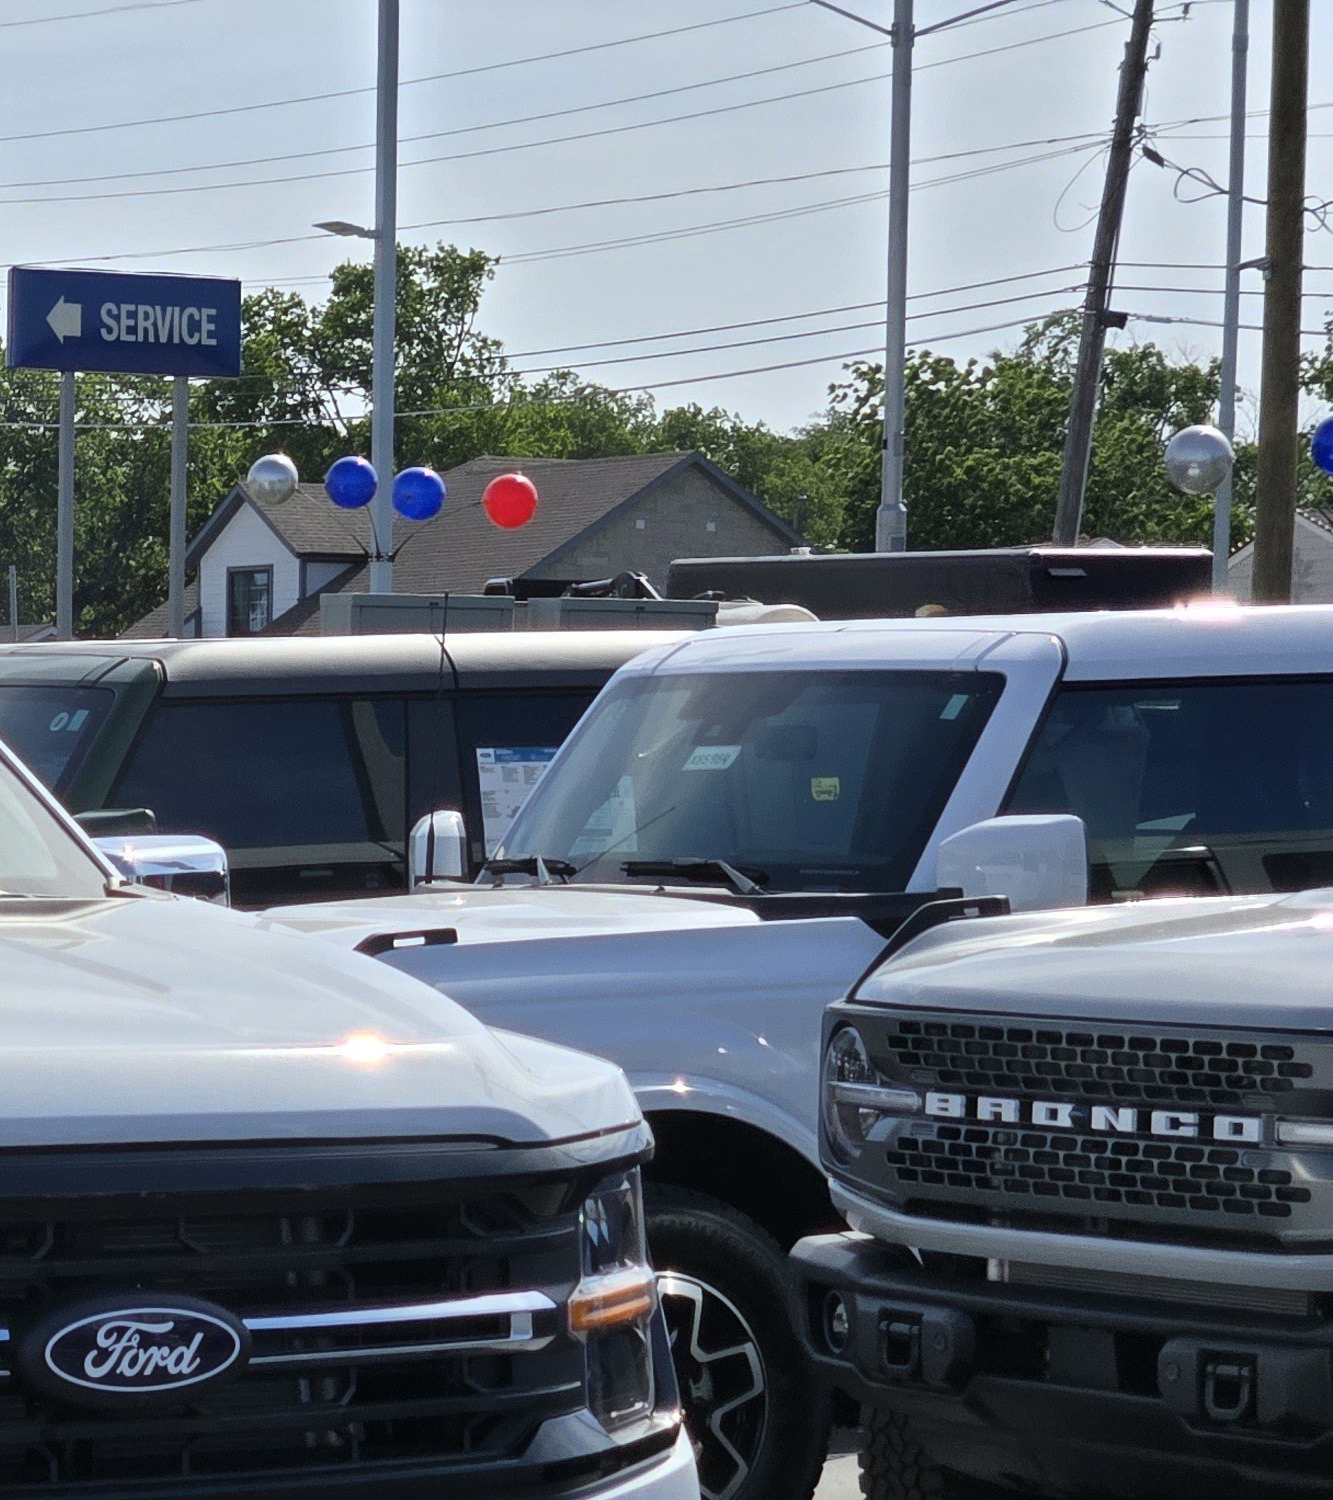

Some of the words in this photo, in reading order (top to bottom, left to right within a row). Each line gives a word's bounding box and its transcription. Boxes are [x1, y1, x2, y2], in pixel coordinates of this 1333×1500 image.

[100, 301, 218, 346] SERVICE
[925, 1091, 1264, 1143] BRONCO
[84, 1320, 204, 1378] Ford
